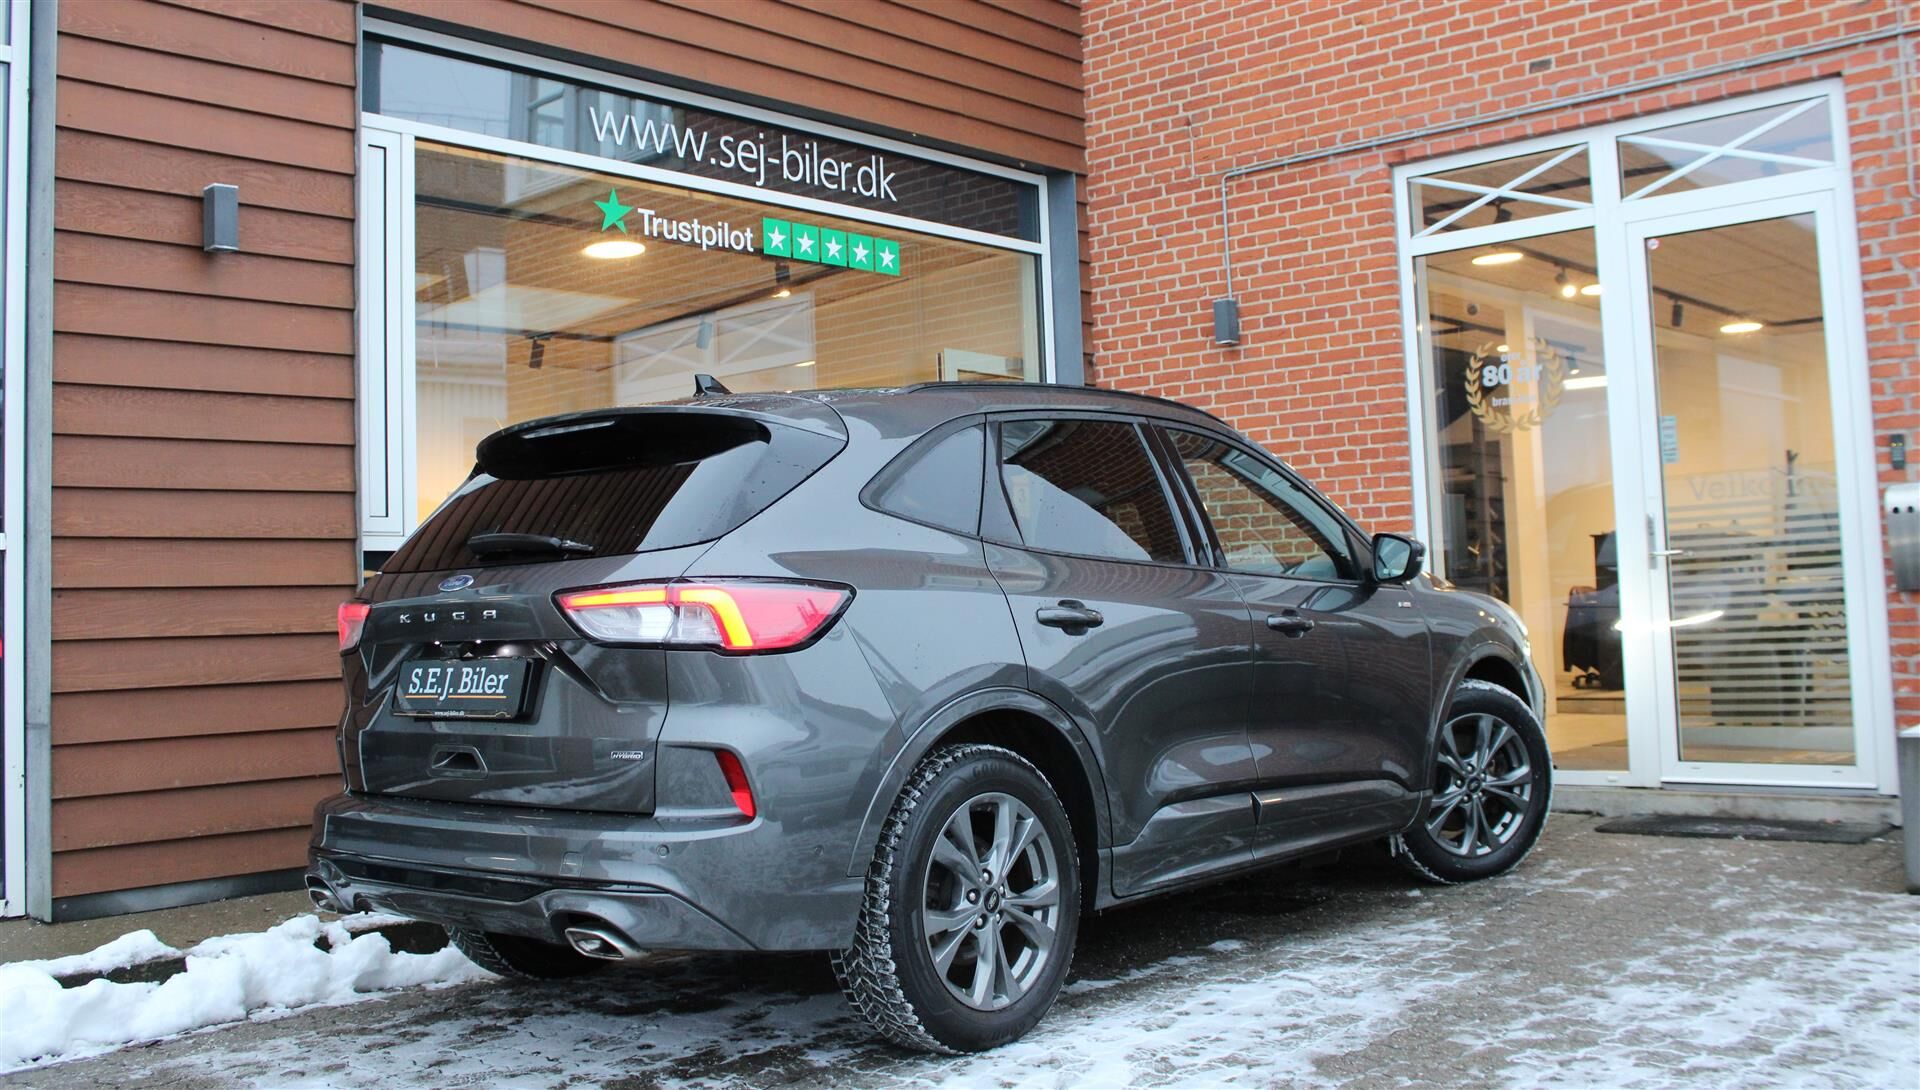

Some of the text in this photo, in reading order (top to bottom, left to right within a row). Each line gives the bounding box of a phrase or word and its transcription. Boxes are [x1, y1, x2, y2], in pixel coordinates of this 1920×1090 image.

[589, 106, 898, 202] www.sej-biler.dk
[637, 208, 754, 253] Trustpilot
[1482, 364, 1512, 388] 80
[399, 608, 498, 625] KUGA
[408, 666, 510, 701] S.E.J. Biler
